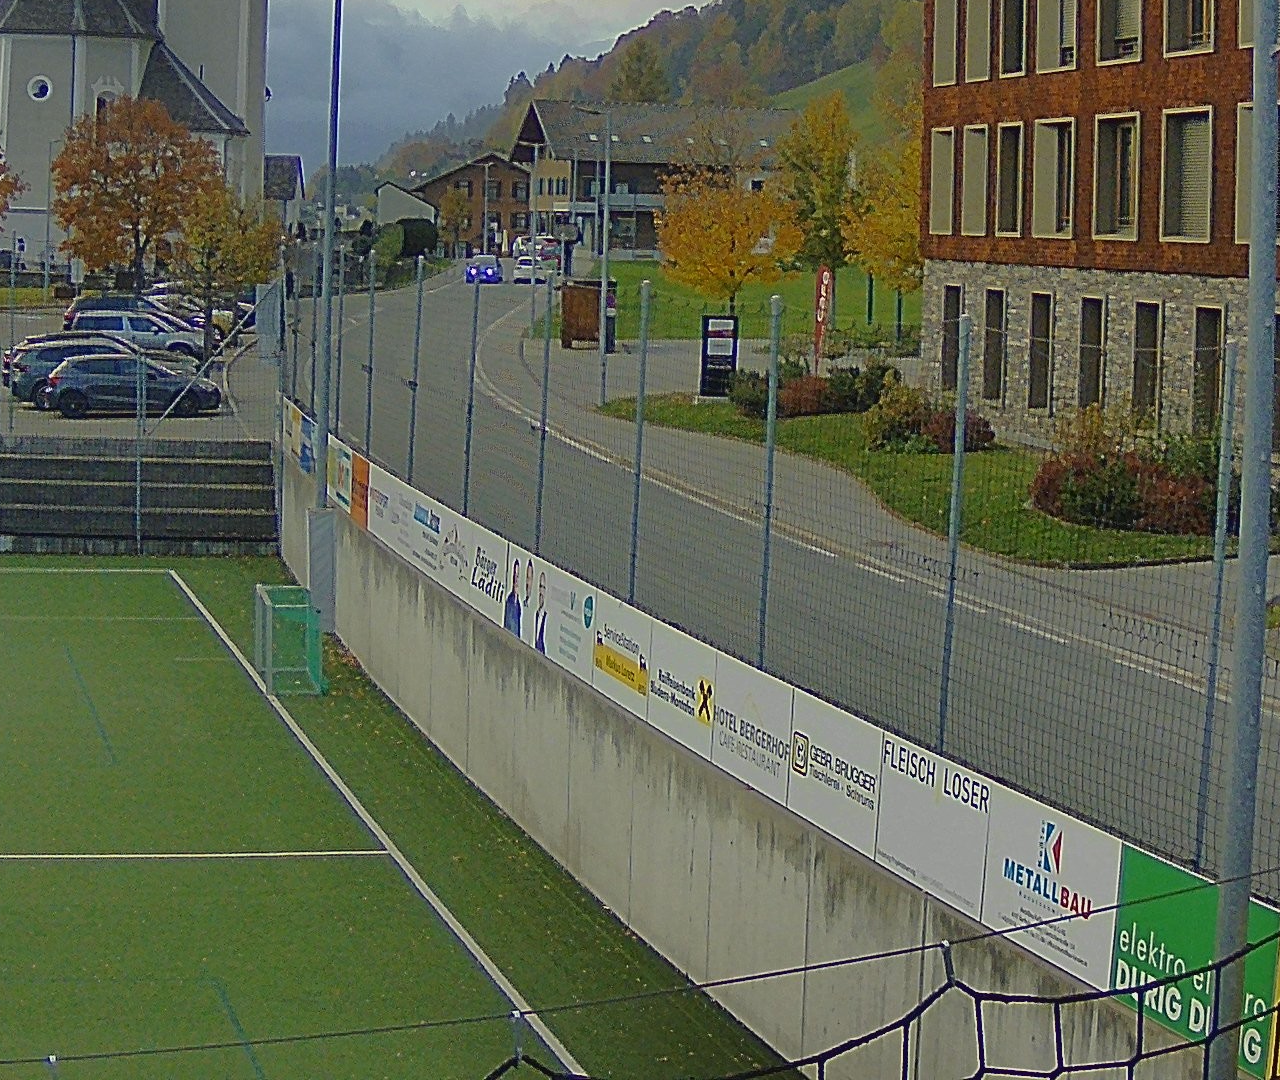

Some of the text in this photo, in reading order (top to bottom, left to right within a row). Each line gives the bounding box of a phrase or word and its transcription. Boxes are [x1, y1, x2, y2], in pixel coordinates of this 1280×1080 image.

[658, 668, 696, 701] Raiffeisenbank
[713, 705, 738, 734] HOTEL
[883, 739, 990, 815] FLEISCH LOSER
[1003, 857, 1093, 920] METALLBAU
[1119, 921, 1186, 977] elektro
[1192, 959, 1267, 1022] elro
